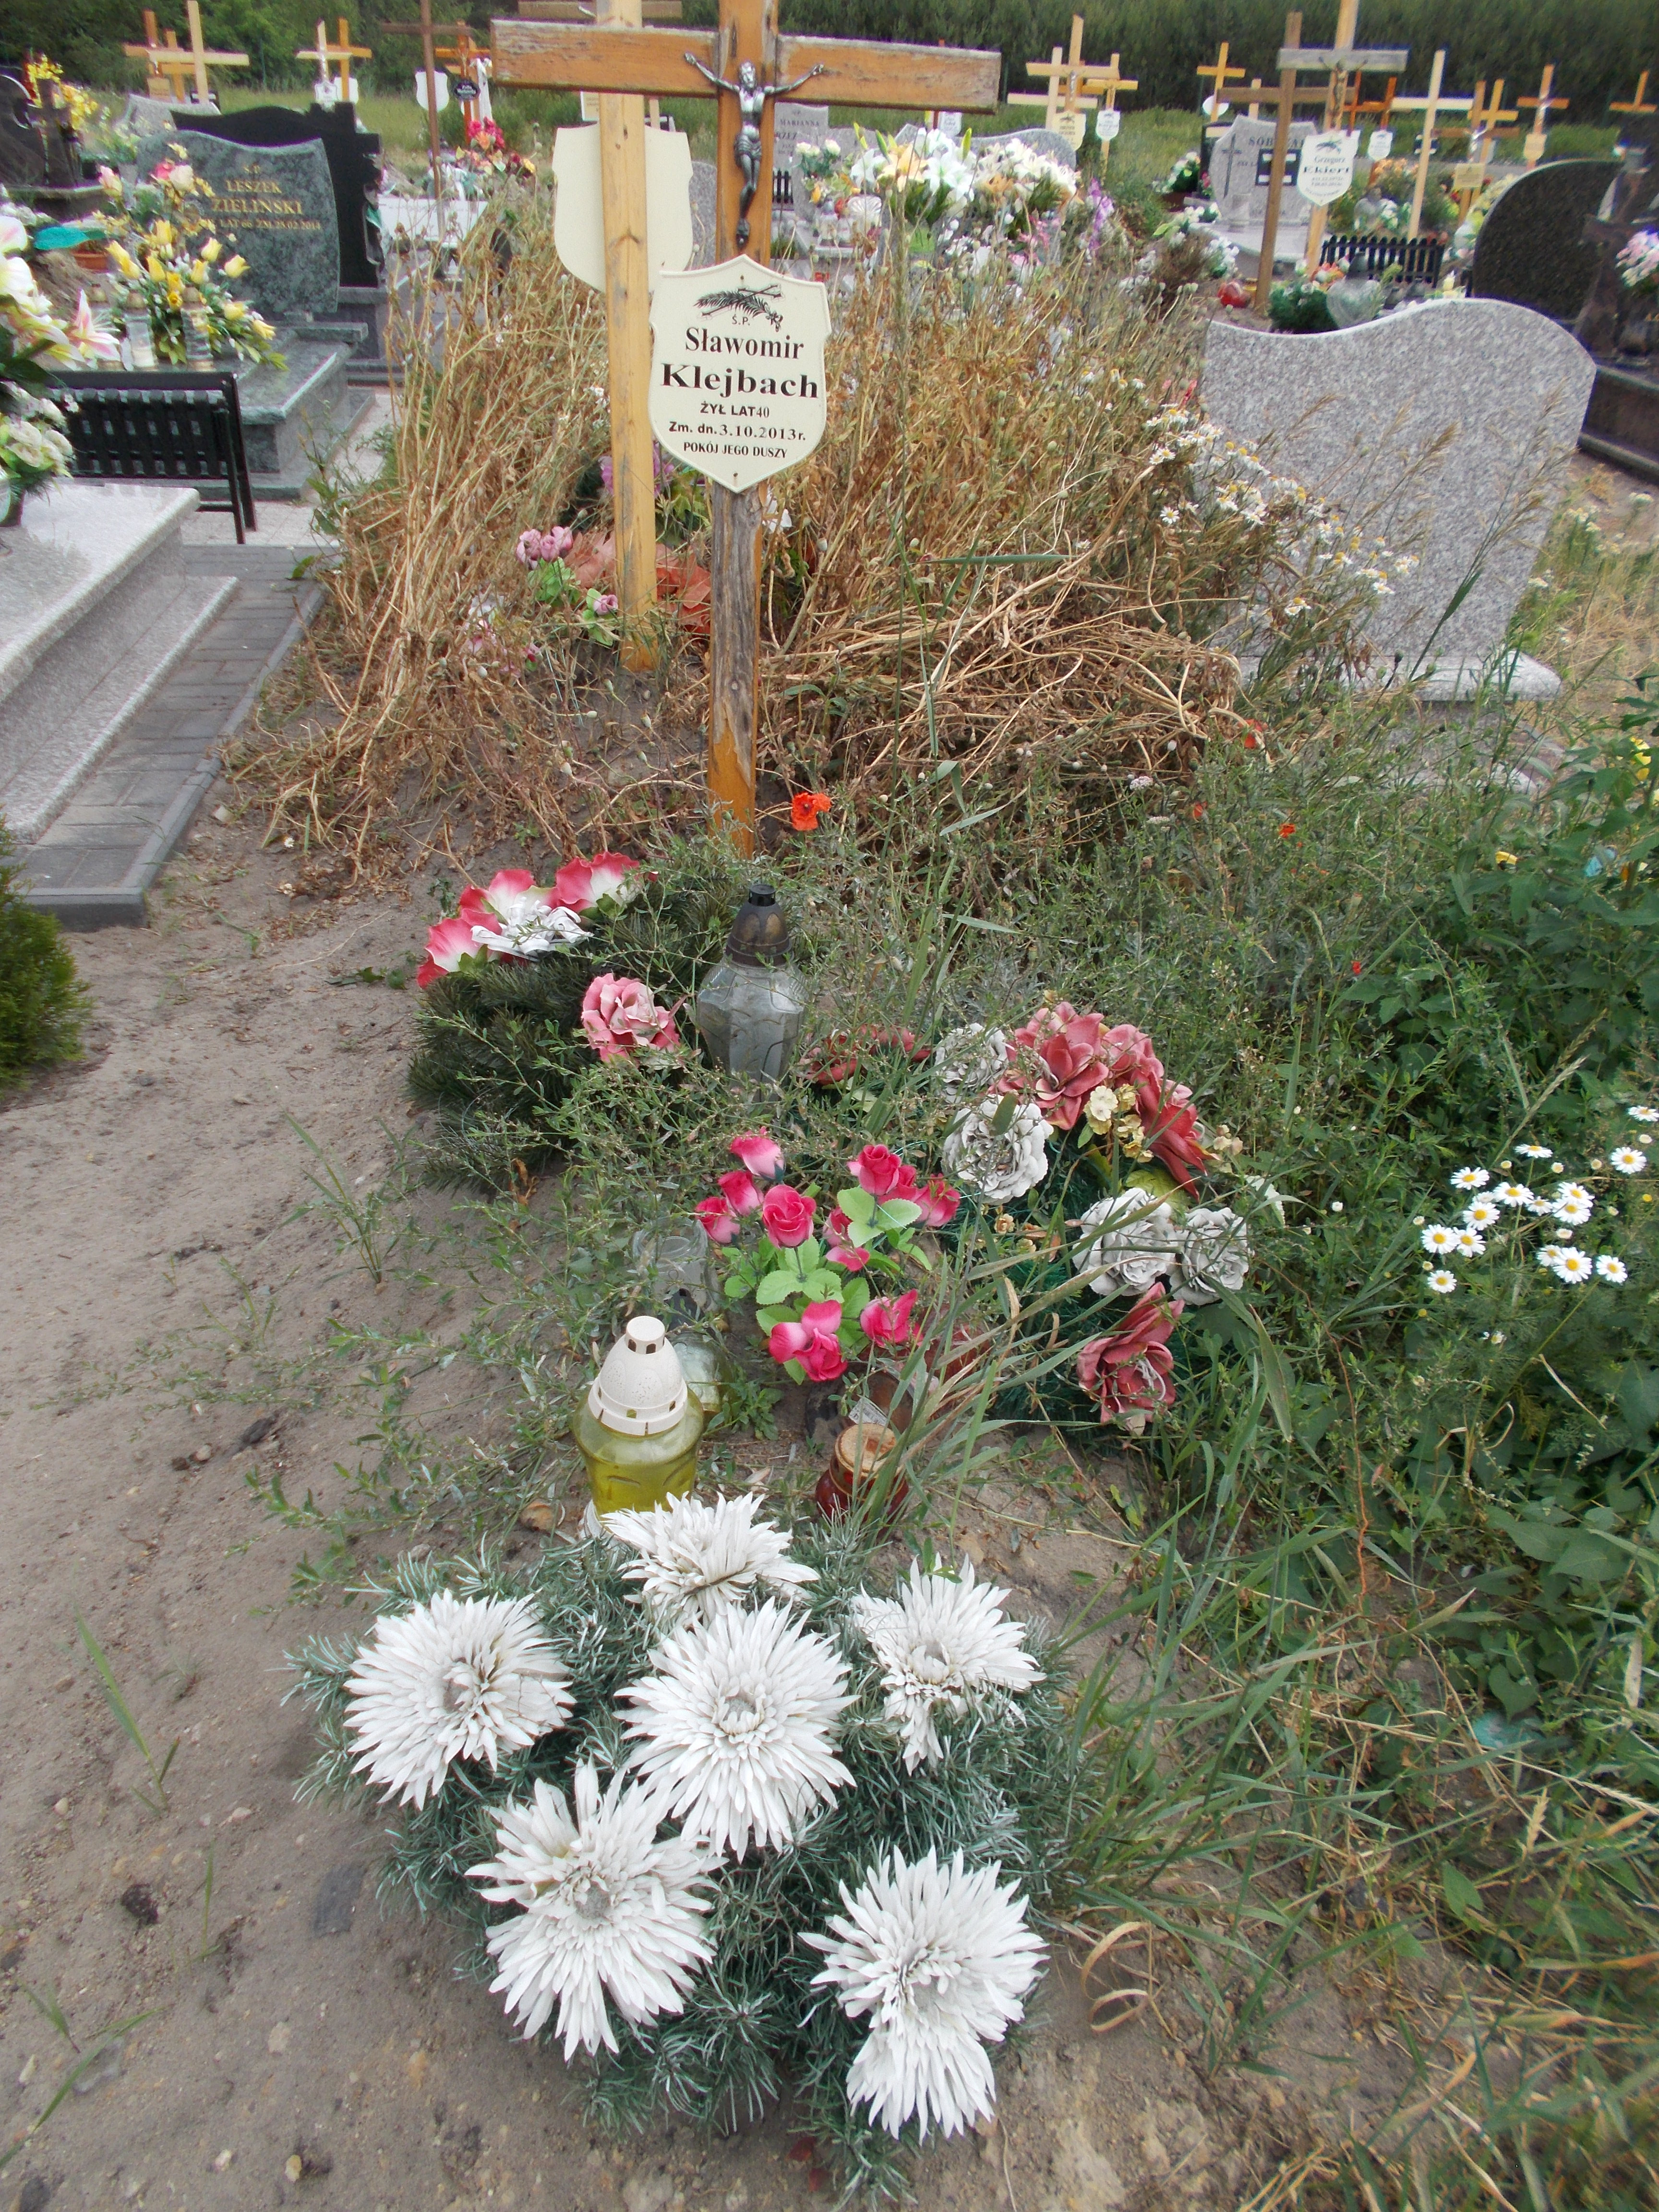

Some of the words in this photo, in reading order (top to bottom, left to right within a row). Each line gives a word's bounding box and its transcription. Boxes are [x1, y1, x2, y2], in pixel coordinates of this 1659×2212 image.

[226, 180, 282, 194] LESZEK
[685, 327, 805, 360] Sławomir
[660, 363, 818, 398] Klejbach
[700, 400, 726, 415] ŻYŁ
[669, 421, 693, 433] Zm.
[684, 441, 719, 454] POKÓJ
[722, 445, 749, 456] JEGO
[753, 447, 788, 459] DUSZY
